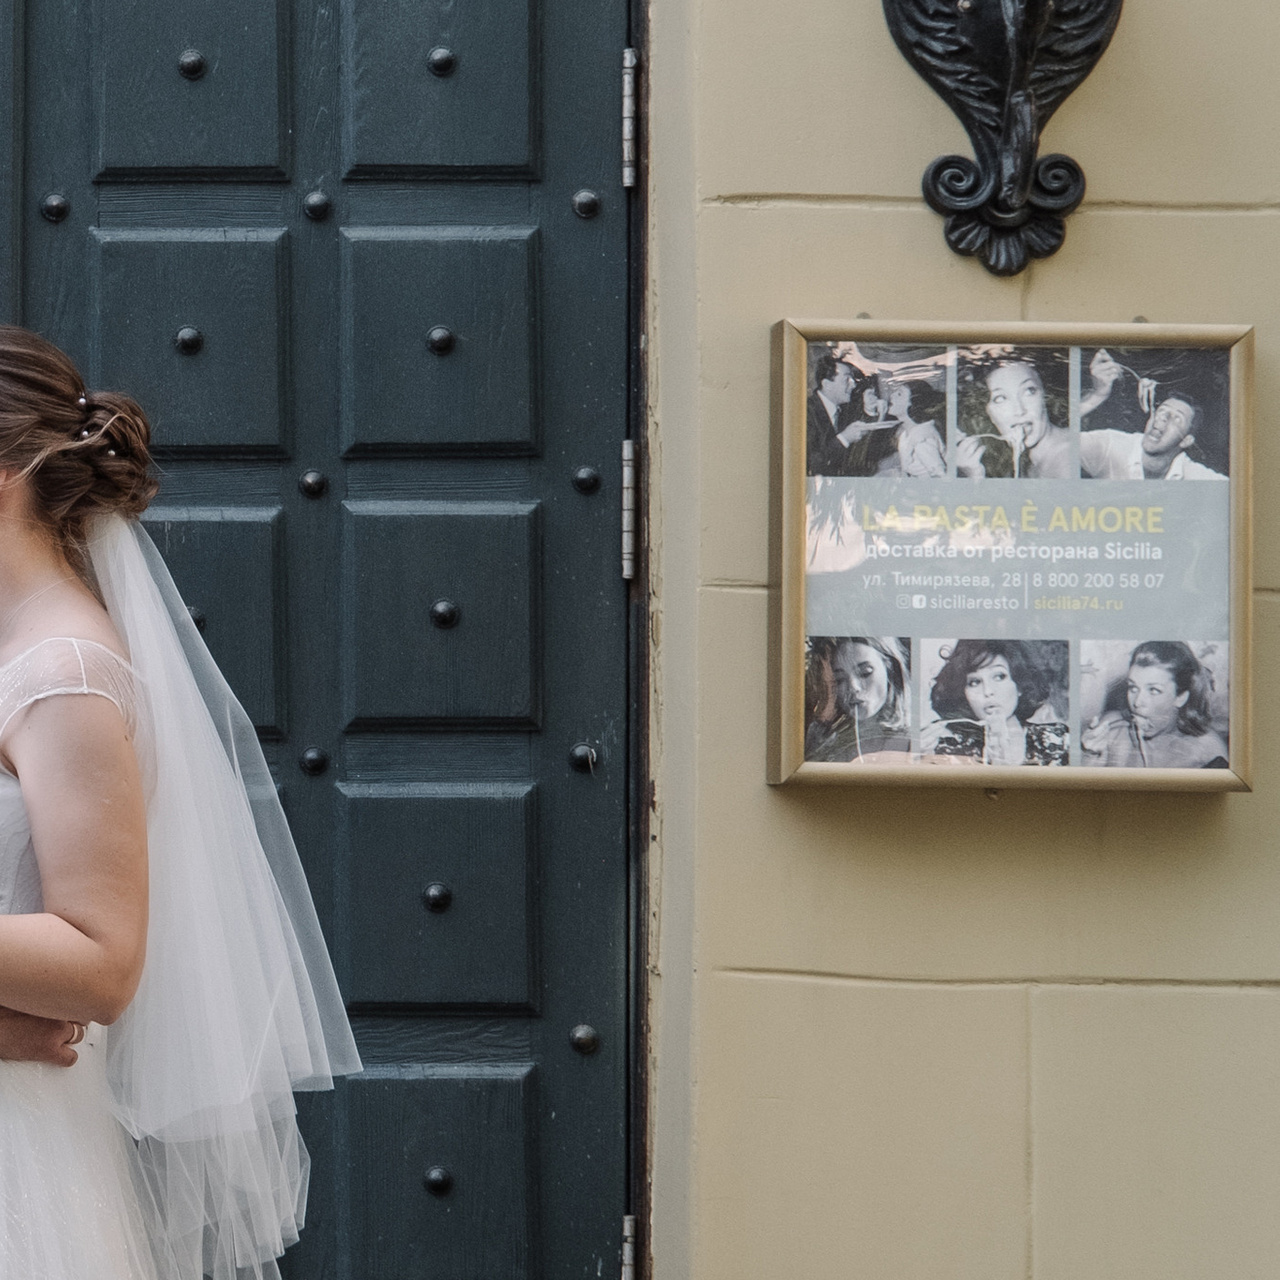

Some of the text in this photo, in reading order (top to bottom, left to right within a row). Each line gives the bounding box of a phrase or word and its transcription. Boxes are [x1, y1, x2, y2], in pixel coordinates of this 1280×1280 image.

[862, 499, 1164, 534] LA PASTA È AMORE
[864, 541, 1163, 563] доставка от ресторана Sicilia
[863, 572, 1164, 591] ул. Тимирязева, 28 8 800 200 58 07
[930, 594, 1124, 612] siciliaresto sicilia74.ru
